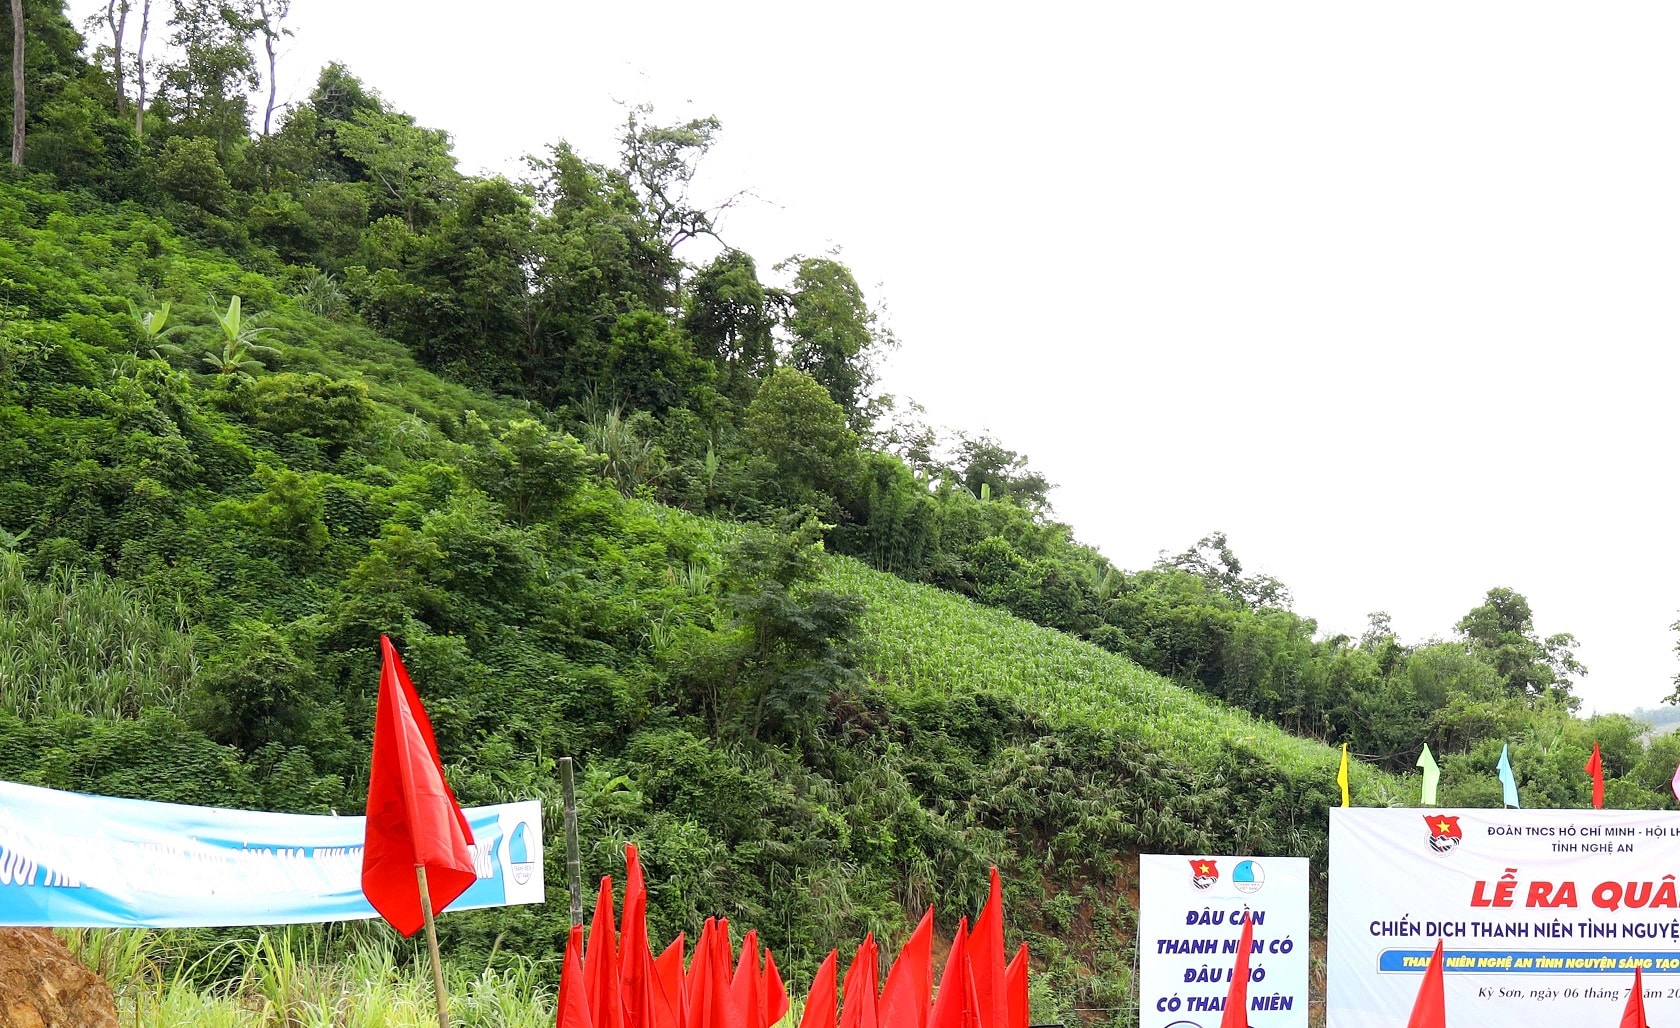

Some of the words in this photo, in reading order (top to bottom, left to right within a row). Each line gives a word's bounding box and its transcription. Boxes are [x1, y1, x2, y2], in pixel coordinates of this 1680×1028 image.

[1487, 825, 1522, 836] ĐOÀN
[1526, 827, 1555, 836] TNCS
[1559, 823, 1577, 836] HỒ
[1580, 824, 1601, 836] CHÍ
[1605, 827, 1635, 837] MINH
[1645, 825, 1667, 839] HỘI
[1581, 841, 1613, 855] NGHỆ
[1616, 843, 1633, 852] AN
[1470, 867, 1518, 908] LỄ
[1525, 881, 1578, 908] RA
[1186, 906, 1225, 926] ĐÂU
[1229, 903, 1265, 926] CẦN
[1369, 913, 1421, 937] CHIẾN
[1471, 922, 1528, 938] THANH
[1534, 918, 1573, 938] NIÊN
[1578, 917, 1617, 938] TÌNH
[1157, 939, 1218, 954] THANH
[1222, 939, 1264, 954] NIN
[1269, 934, 1293, 954] CÓ
[1446, 955, 1475, 968] NIÊN
[1477, 954, 1512, 971] NGHỆ
[1514, 957, 1533, 968] AN
[1534, 955, 1563, 968] TÌNH
[1565, 956, 1617, 971] NGUYỆN
[1618, 956, 1653, 969] SÁNG
[1655, 958, 1680, 971] TẠO
[1184, 964, 1222, 983] ĐÂU
[1156, 992, 1181, 1012] CÓ
[1251, 992, 1293, 1011] NIÊN
[1478, 987, 1494, 1000] Kỳ
[1498, 988, 1525, 999] Sơn,
[1529, 987, 1559, 1001] ngày
[1563, 988, 1579, 998] 06
[1584, 987, 1619, 1001] tháng
